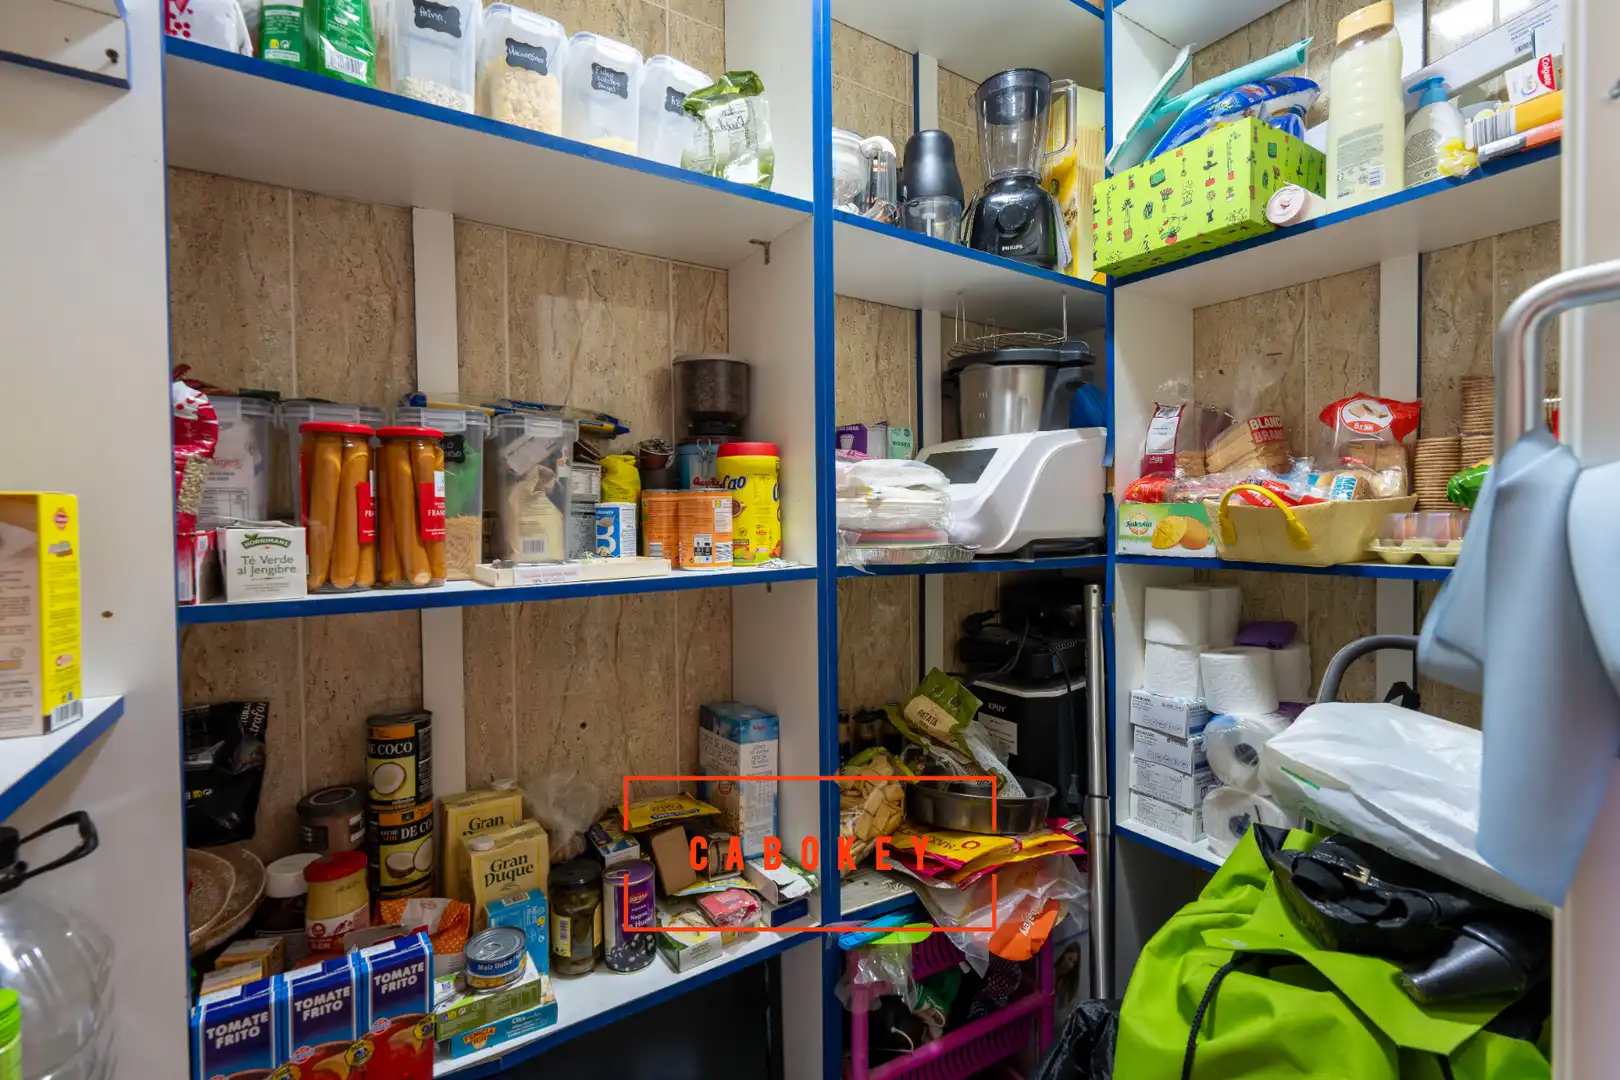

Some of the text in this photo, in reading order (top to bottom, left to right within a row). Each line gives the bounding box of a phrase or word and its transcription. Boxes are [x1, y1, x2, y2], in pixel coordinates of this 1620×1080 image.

[1540, 57, 1552, 86] Colgate
[240, 554, 294, 565] Té Verde
[236, 566, 247, 575] al
[377, 741, 413, 756] COCO
[400, 825, 418, 840] DE
[468, 815, 505, 831] Gran
[490, 854, 529, 873] Gran
[484, 863, 534, 887] Duque
[374, 962, 425, 985] TOMATE
[381, 975, 418, 994] FRITO
[294, 986, 351, 1012] TOMATE
[302, 1000, 344, 1021] FRITO
[206, 1011, 269, 1040] TOMATE
[215, 1025, 261, 1049] FRITO
